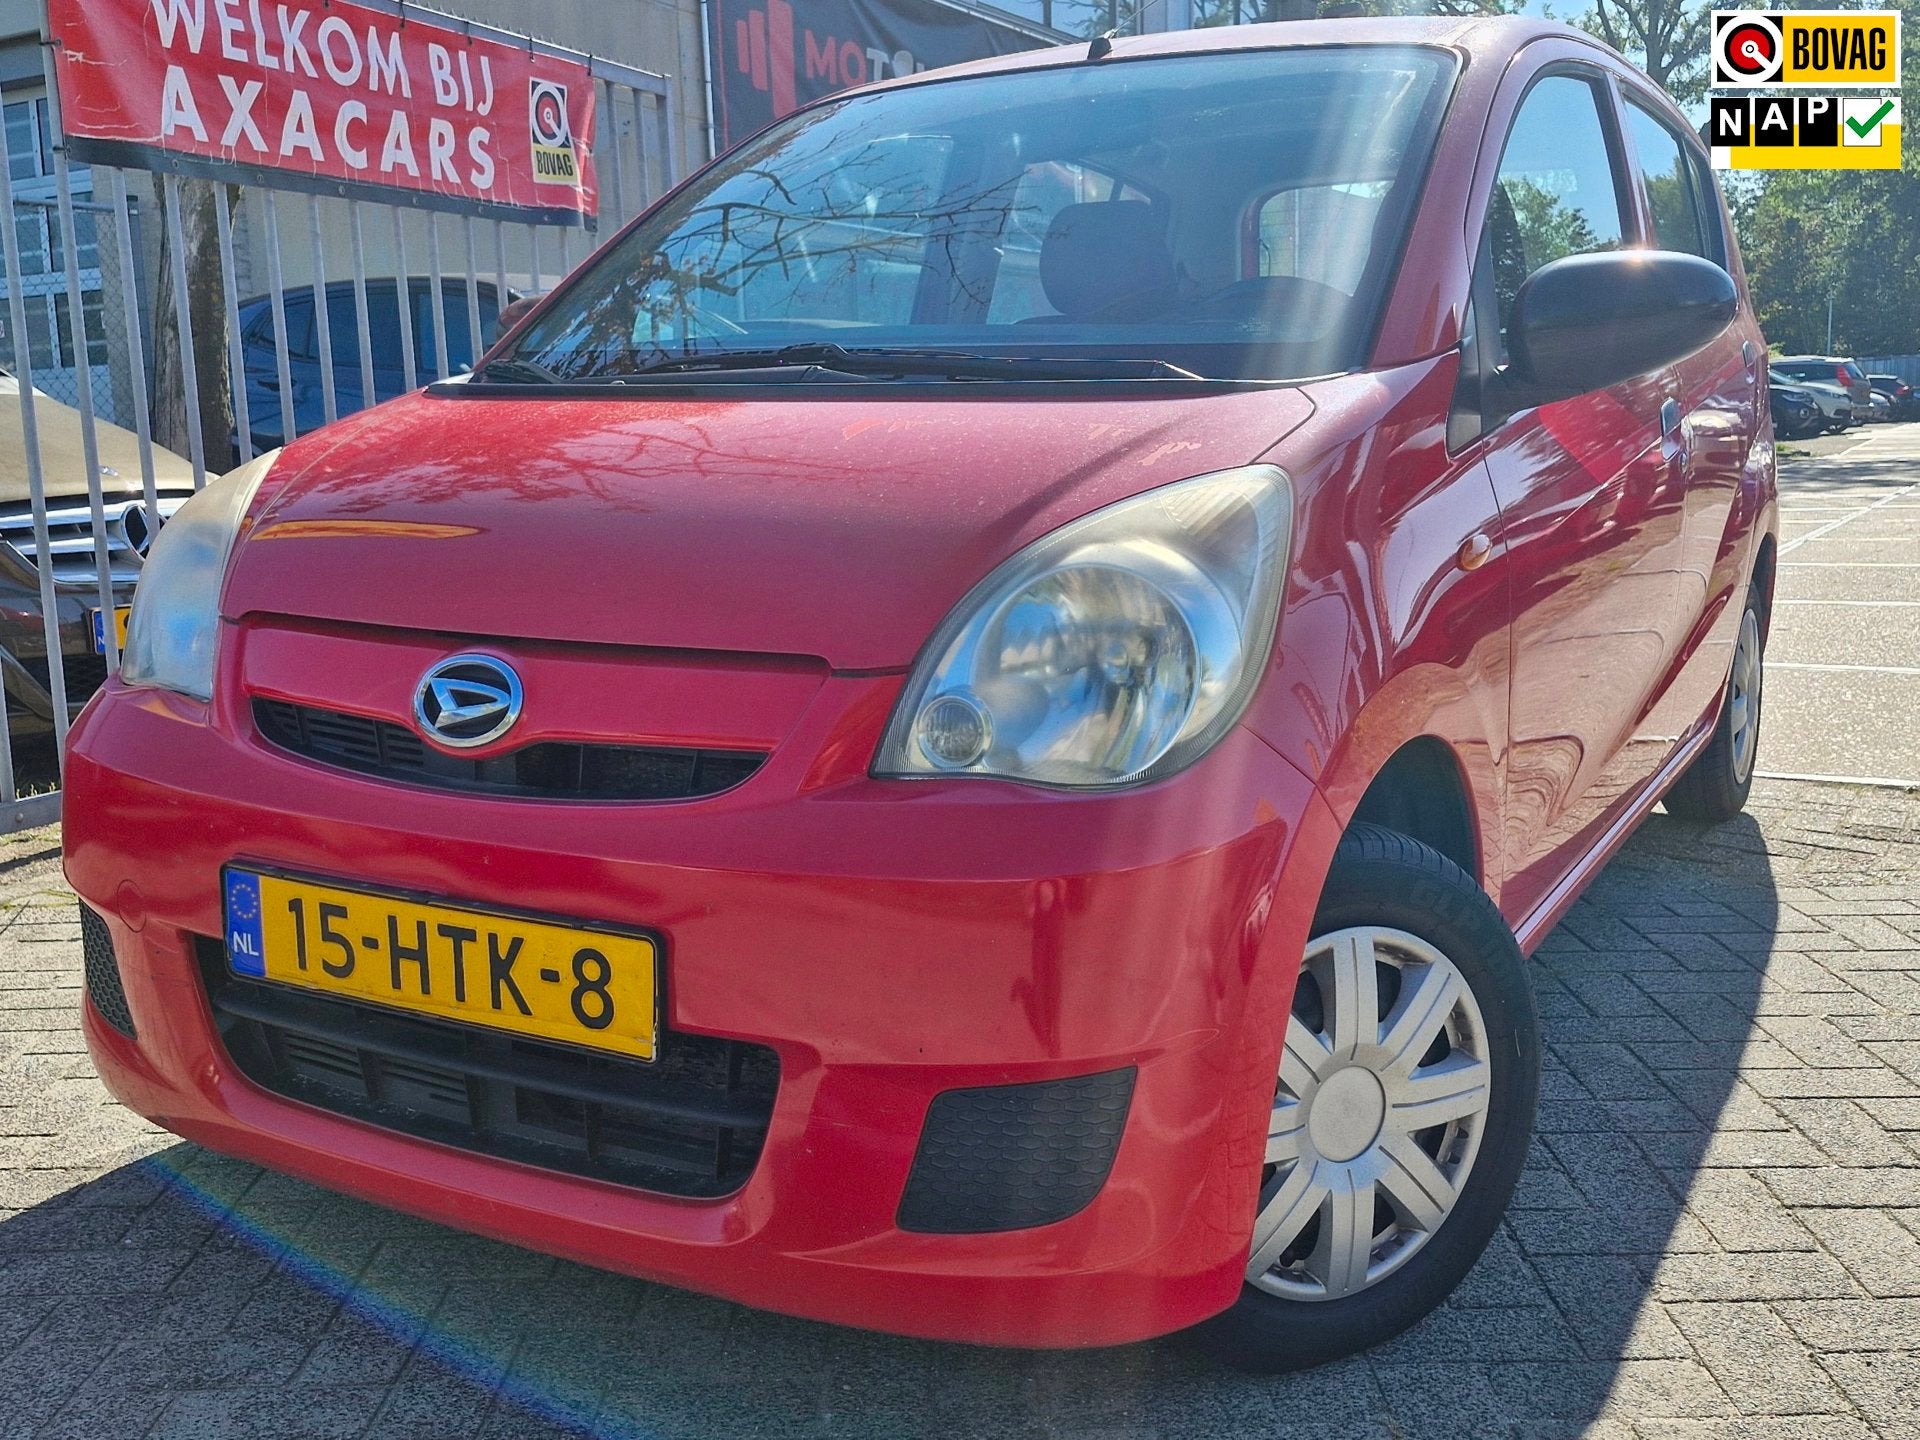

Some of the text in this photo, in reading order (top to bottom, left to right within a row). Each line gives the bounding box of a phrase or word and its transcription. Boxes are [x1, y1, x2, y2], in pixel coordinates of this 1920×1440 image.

[153, 0, 494, 116] WELKOM BIJ
[161, 65, 496, 190] AXACARS
[535, 150, 574, 177] BOVAG
[233, 931, 259, 956] NL
[288, 898, 615, 1030] 15-HTK-8
